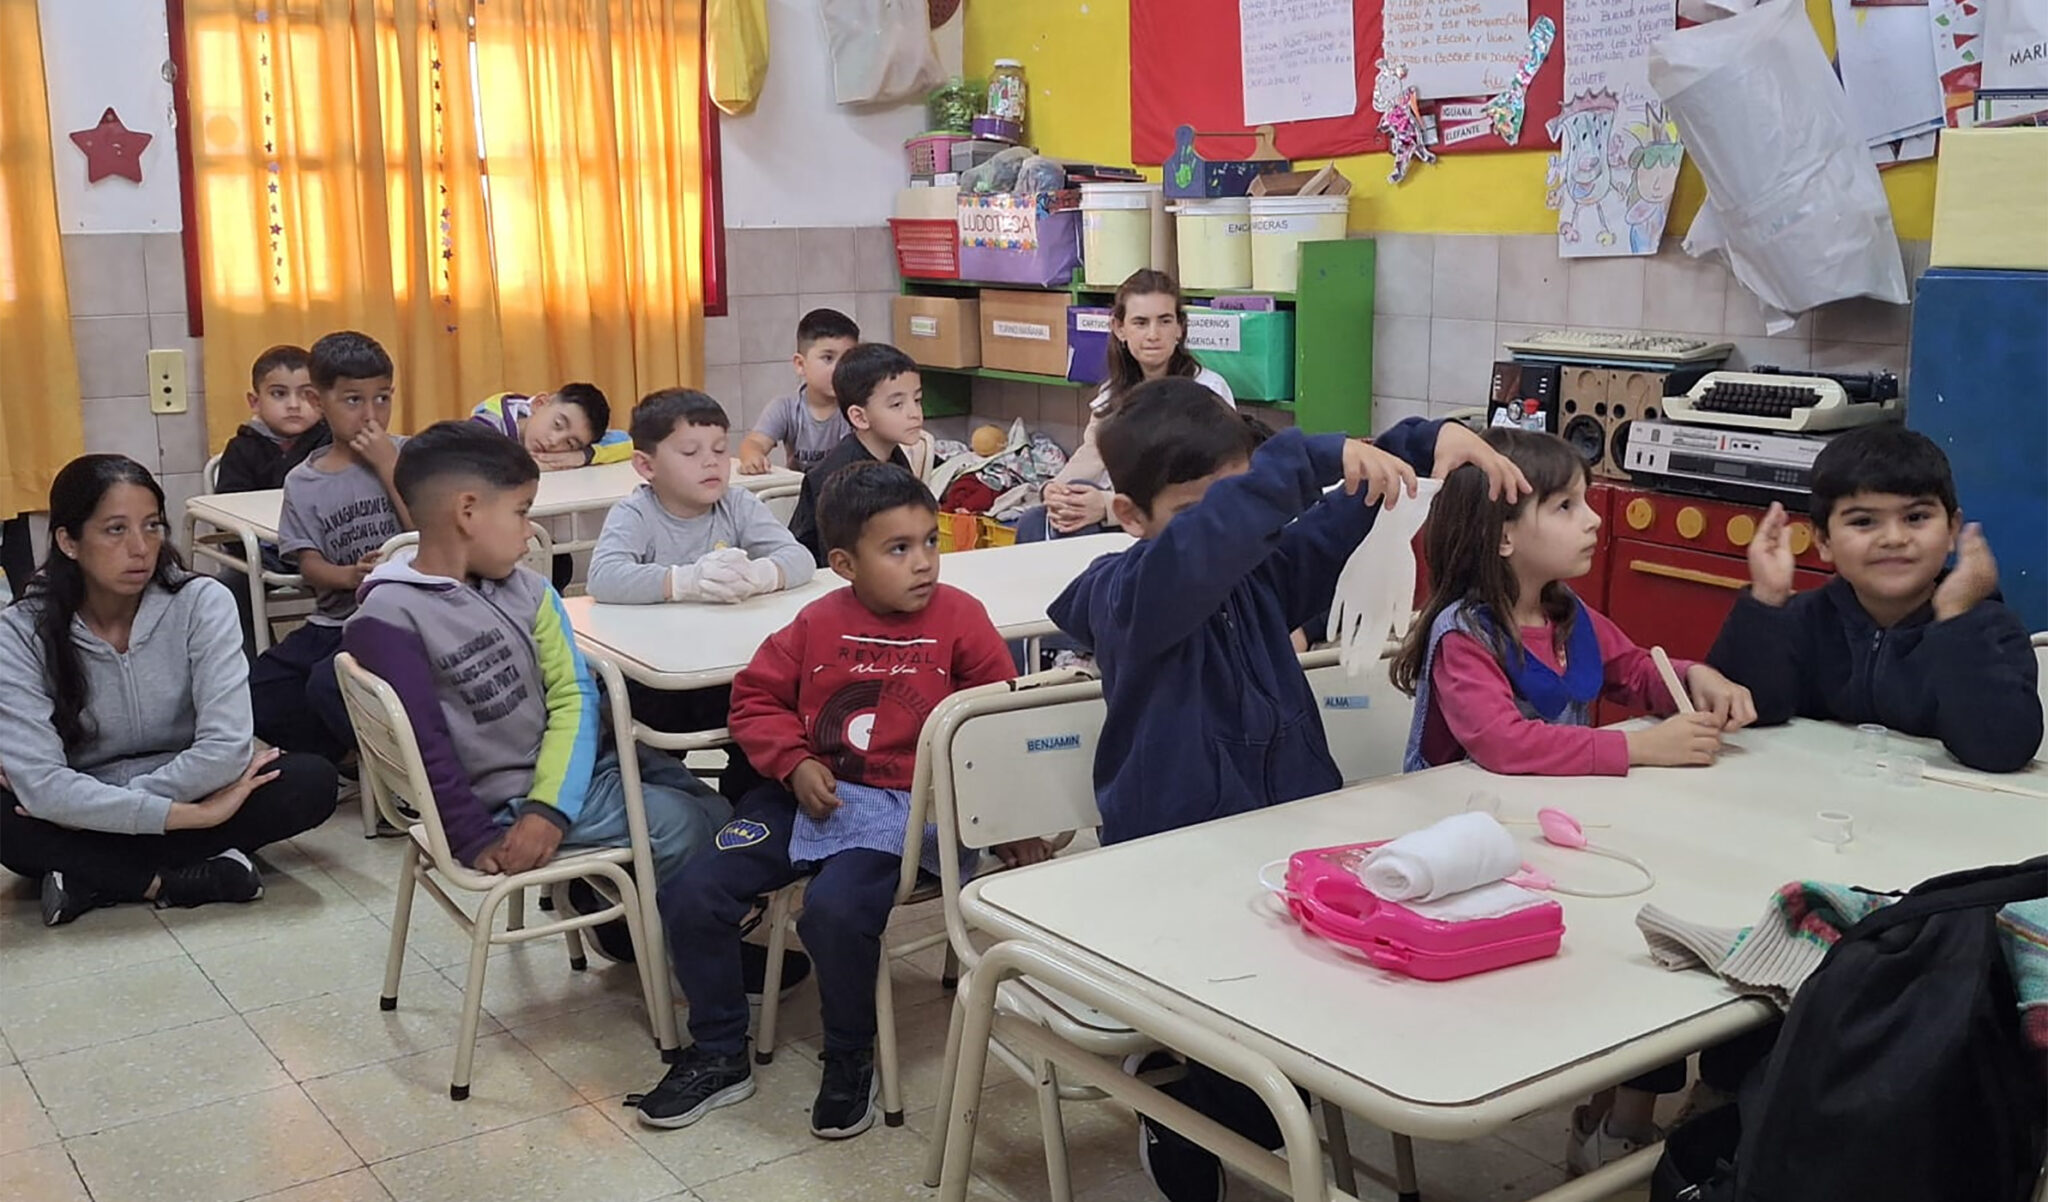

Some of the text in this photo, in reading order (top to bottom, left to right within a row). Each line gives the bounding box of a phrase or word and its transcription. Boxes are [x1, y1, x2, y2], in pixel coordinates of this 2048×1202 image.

[1445, 125, 1481, 141] ELEFANTE
[838, 646, 934, 664] REVIVAL
[1324, 695, 1351, 709] ALMA
[1027, 734, 1081, 752] BENJAMIN
